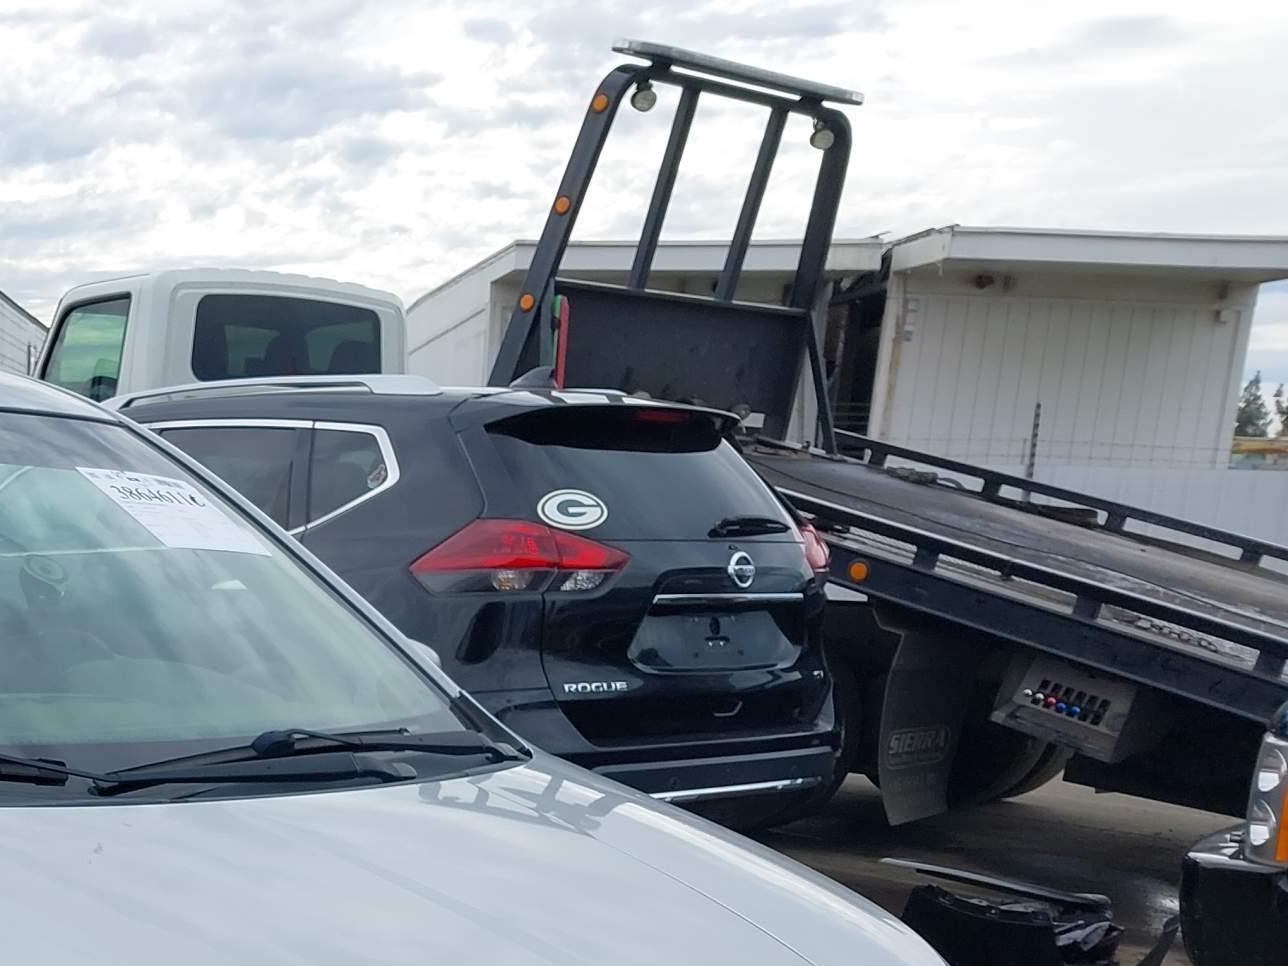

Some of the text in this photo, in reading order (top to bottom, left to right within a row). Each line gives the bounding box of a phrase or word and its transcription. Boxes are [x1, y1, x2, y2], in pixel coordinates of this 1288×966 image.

[541, 491, 605, 528] G
[562, 680, 629, 694] ROGUE
[887, 730, 946, 755] SIERRA
